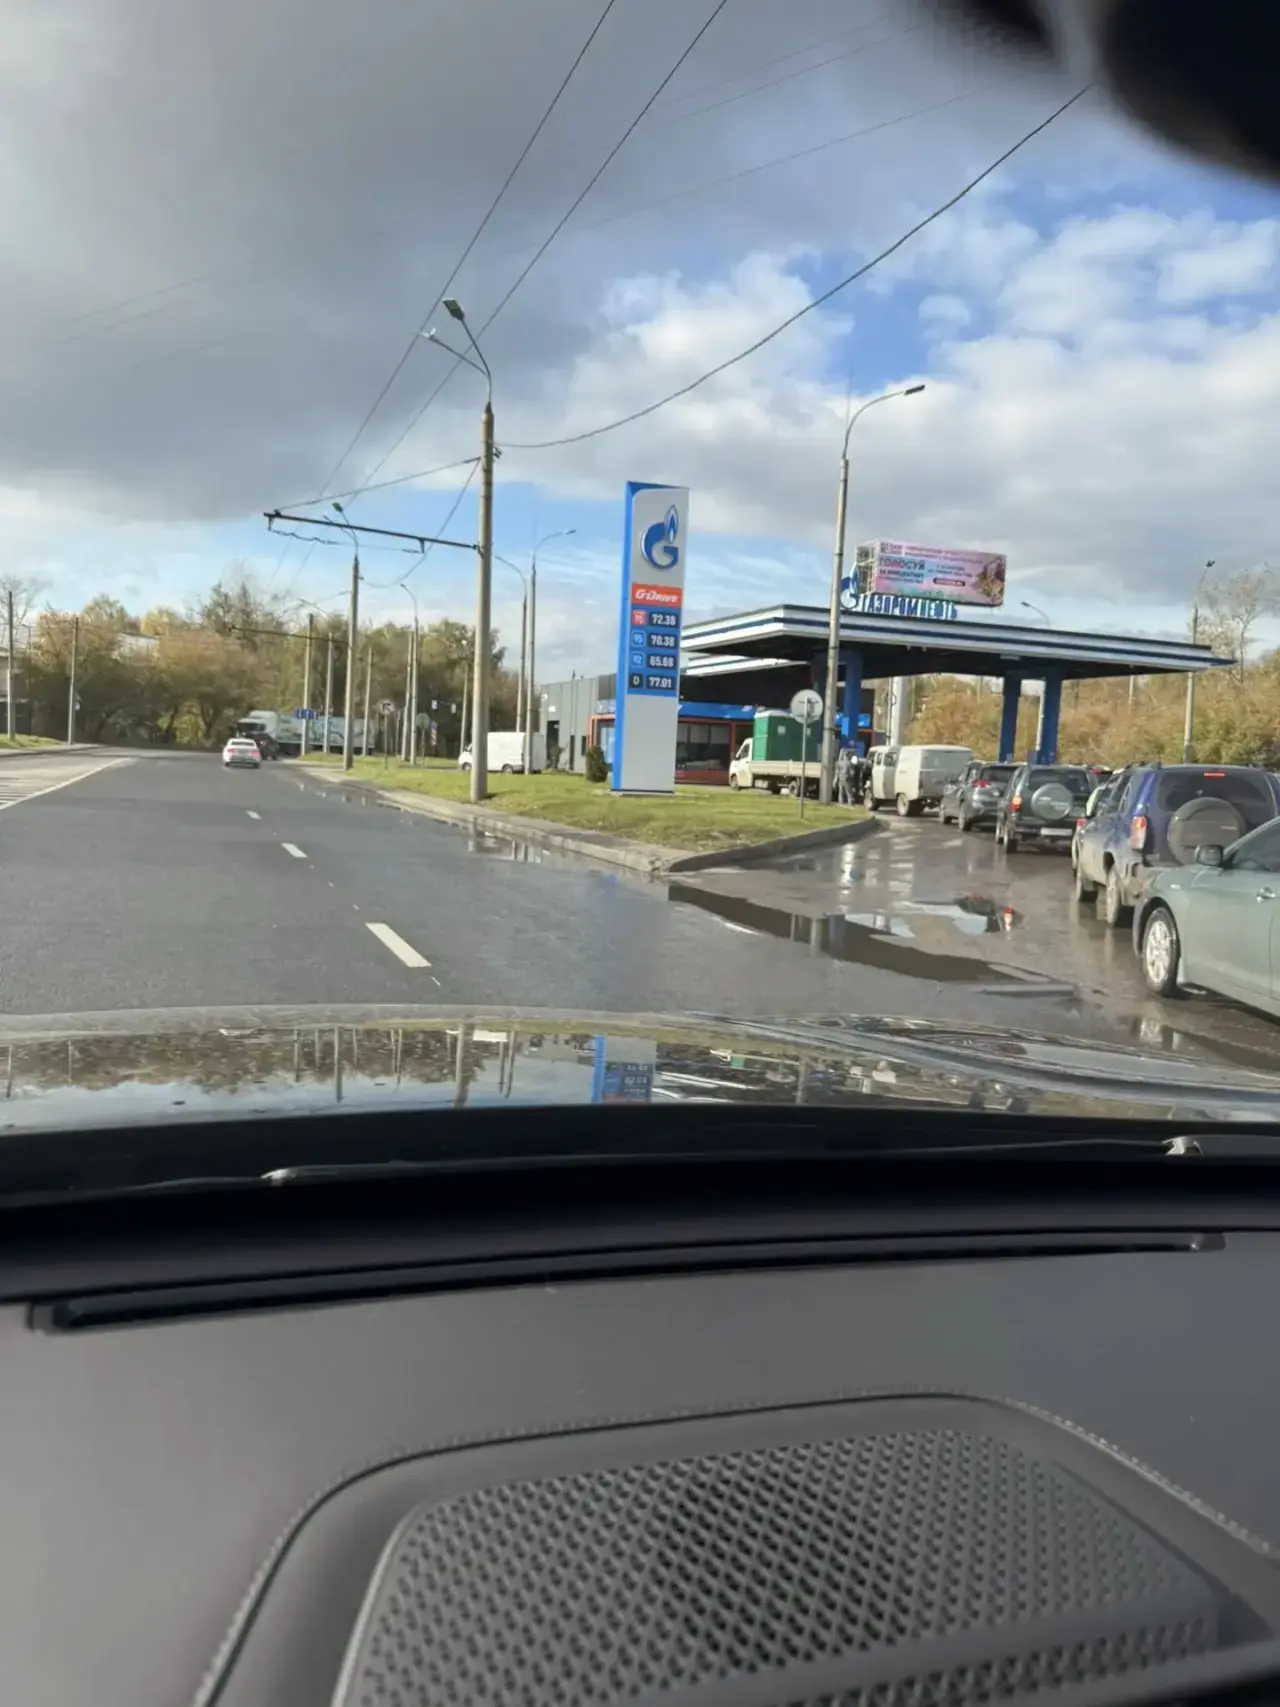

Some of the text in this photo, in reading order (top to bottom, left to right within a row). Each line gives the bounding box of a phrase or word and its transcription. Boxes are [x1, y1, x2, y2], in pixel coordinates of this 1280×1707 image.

[651, 613, 676, 626] 72.38
[651, 634, 675, 647] 70.38
[649, 676, 672, 688] 77.01
